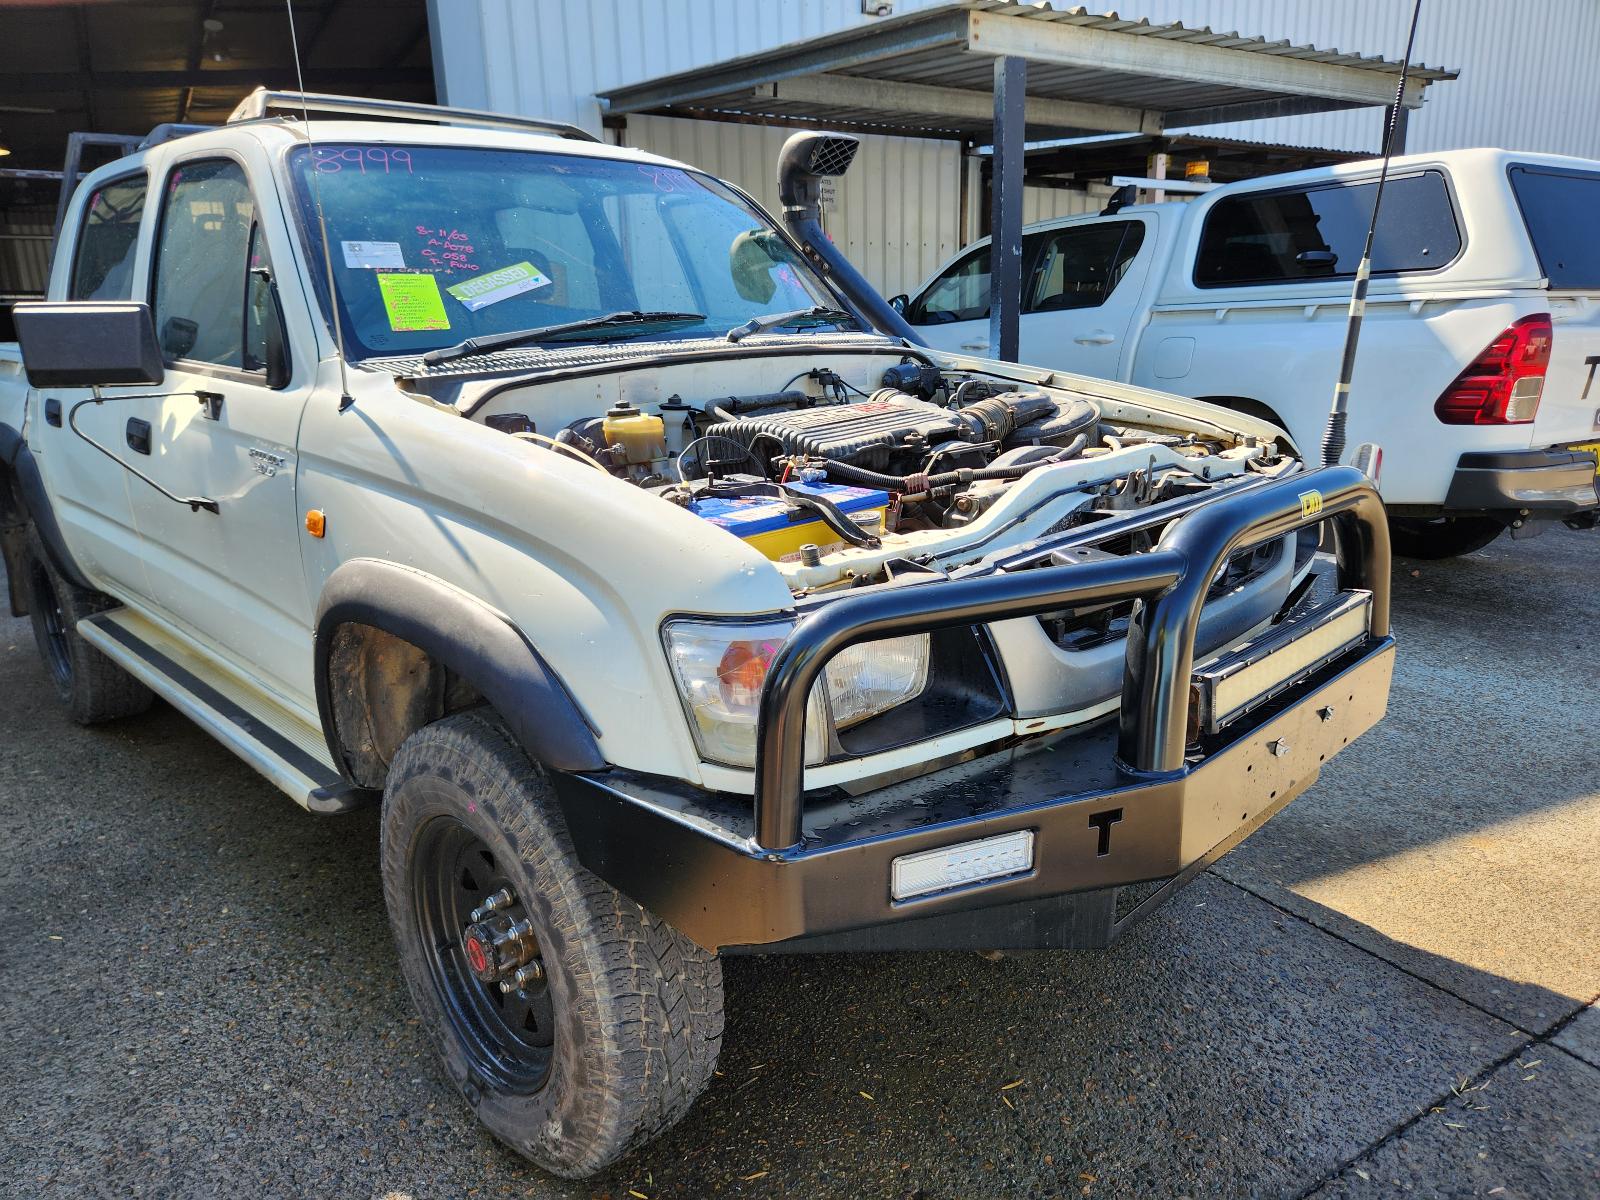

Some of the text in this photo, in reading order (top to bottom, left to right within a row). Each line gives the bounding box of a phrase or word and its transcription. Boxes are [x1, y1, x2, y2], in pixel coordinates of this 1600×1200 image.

[312, 148, 413, 175] 8999
[459, 267, 529, 296] DEGASSED
[1088, 807, 1124, 857] T
